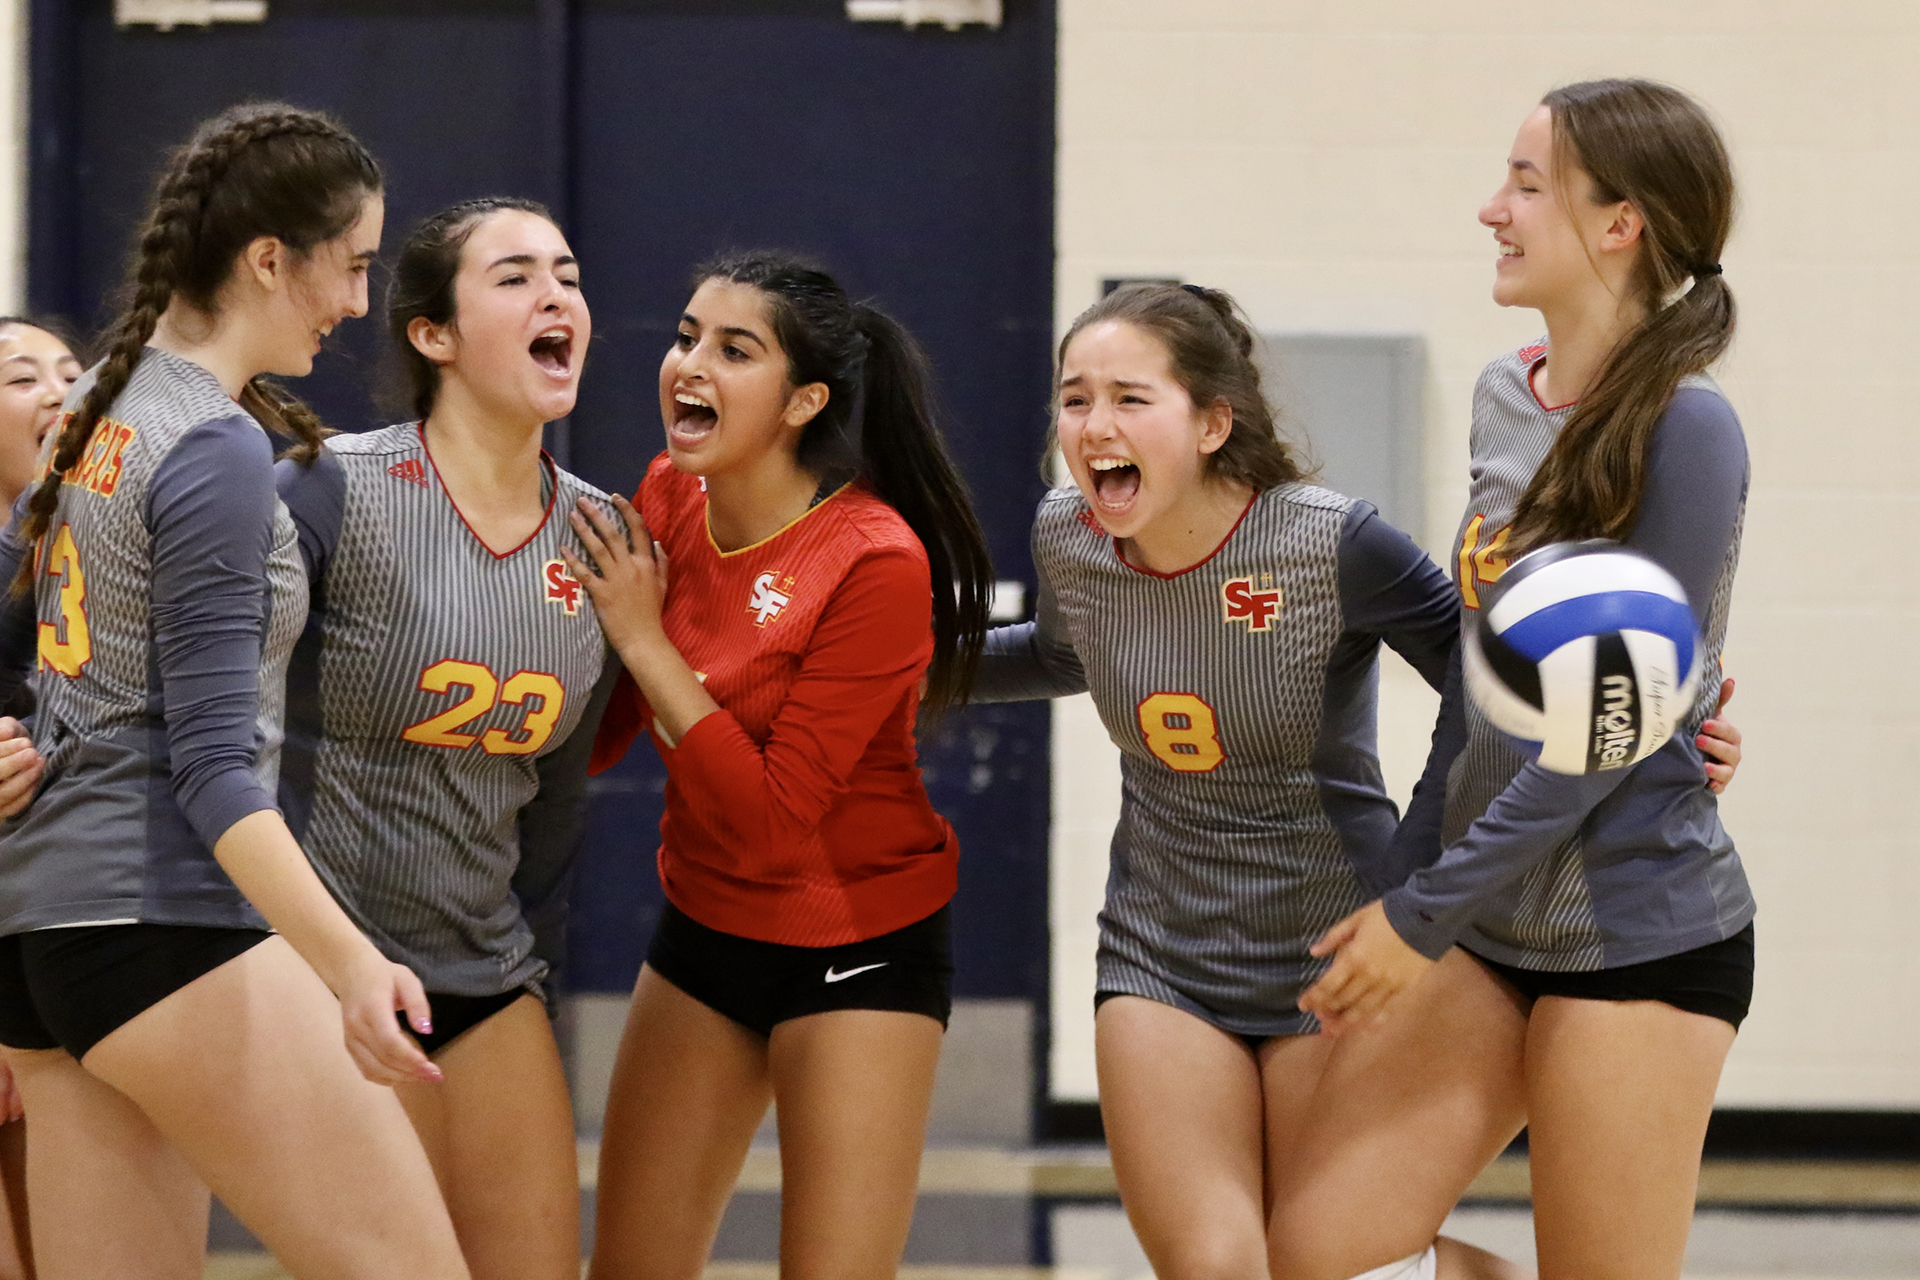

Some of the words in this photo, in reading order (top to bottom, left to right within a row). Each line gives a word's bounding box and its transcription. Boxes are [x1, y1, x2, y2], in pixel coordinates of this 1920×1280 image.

[33, 522, 91, 679] 3
[542, 558, 583, 616] SF
[746, 570, 793, 628] SF
[1220, 574, 1283, 633] SF
[1458, 513, 1513, 610] 14
[401, 658, 565, 756] 23
[1137, 691, 1227, 773] 8
[1598, 674, 1636, 771] molten
